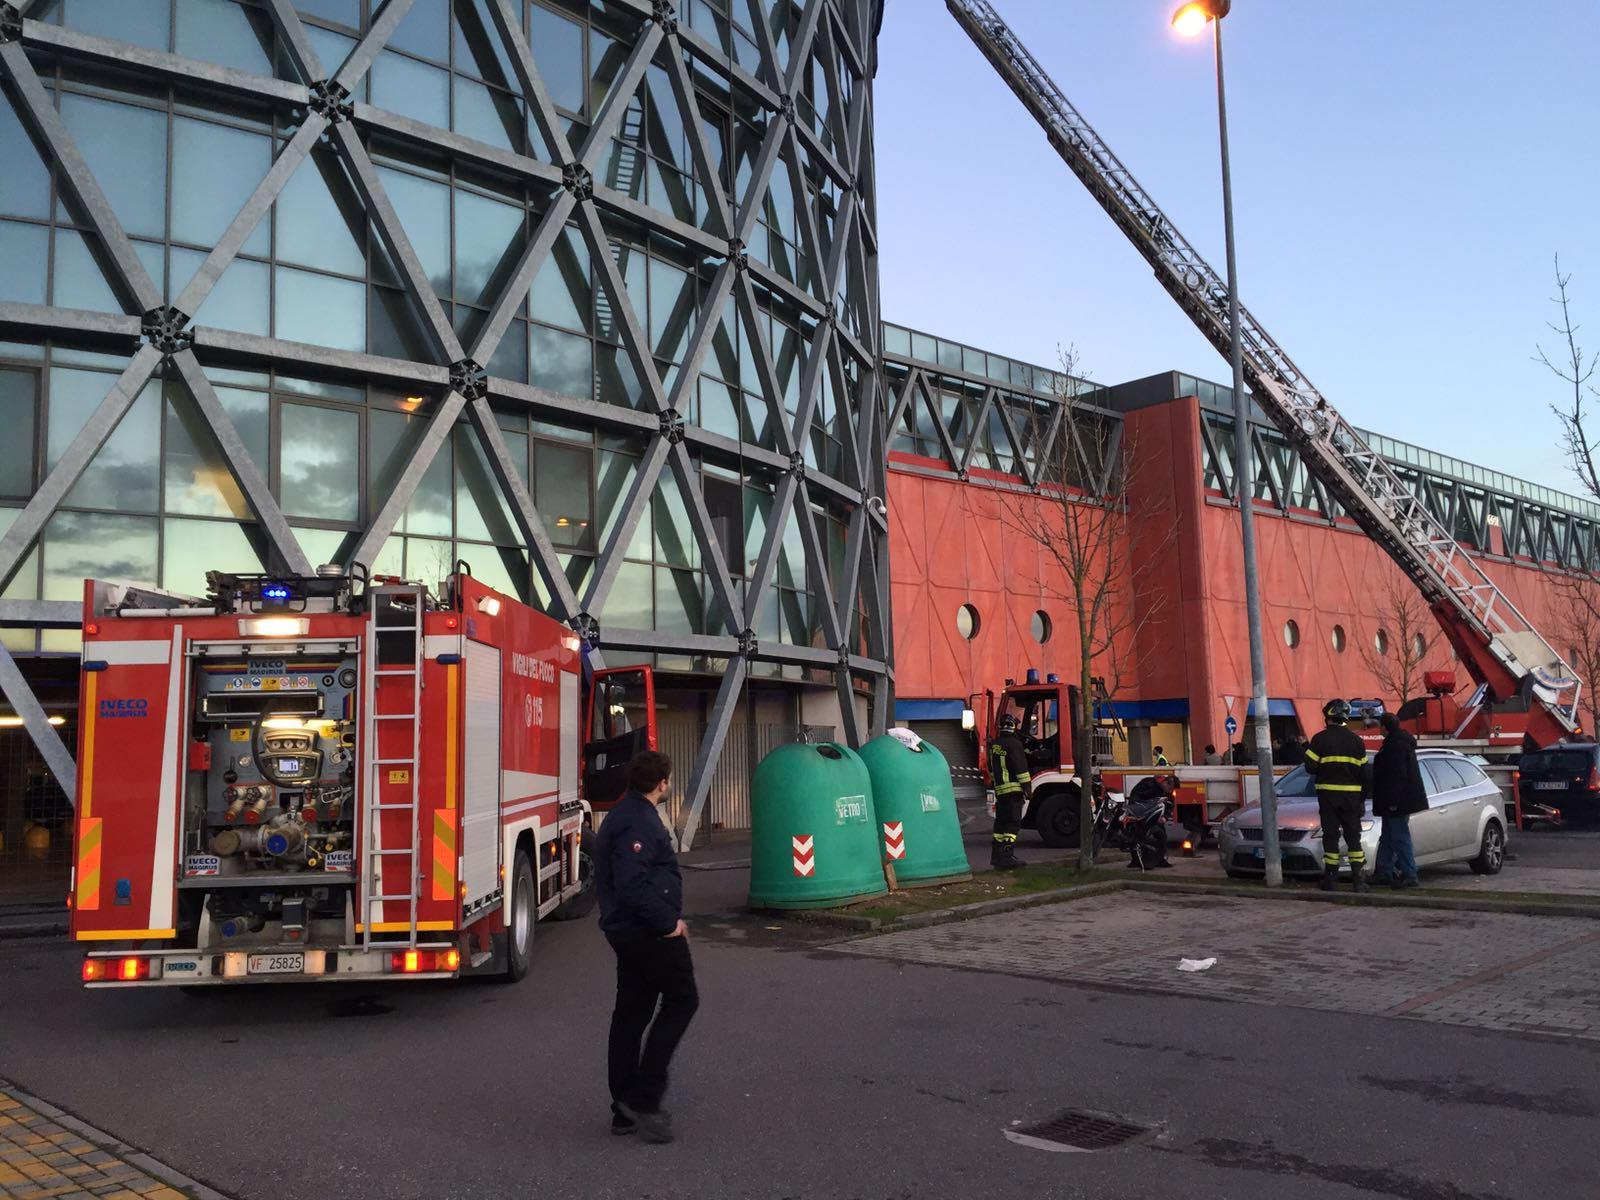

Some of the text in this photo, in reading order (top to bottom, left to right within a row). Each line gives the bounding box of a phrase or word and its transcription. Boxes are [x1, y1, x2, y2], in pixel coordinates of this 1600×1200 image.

[250, 660, 284, 668] IVECO
[512, 652, 555, 684] VIGILI DEL FUOCO
[100, 698, 148, 709] IVECO
[532, 696, 543, 726] 115
[838, 803, 861, 818] VETRO
[188, 857, 218, 865] IVECO
[165, 962, 197, 971] IVECO
[250, 956, 302, 970] VF 25825
